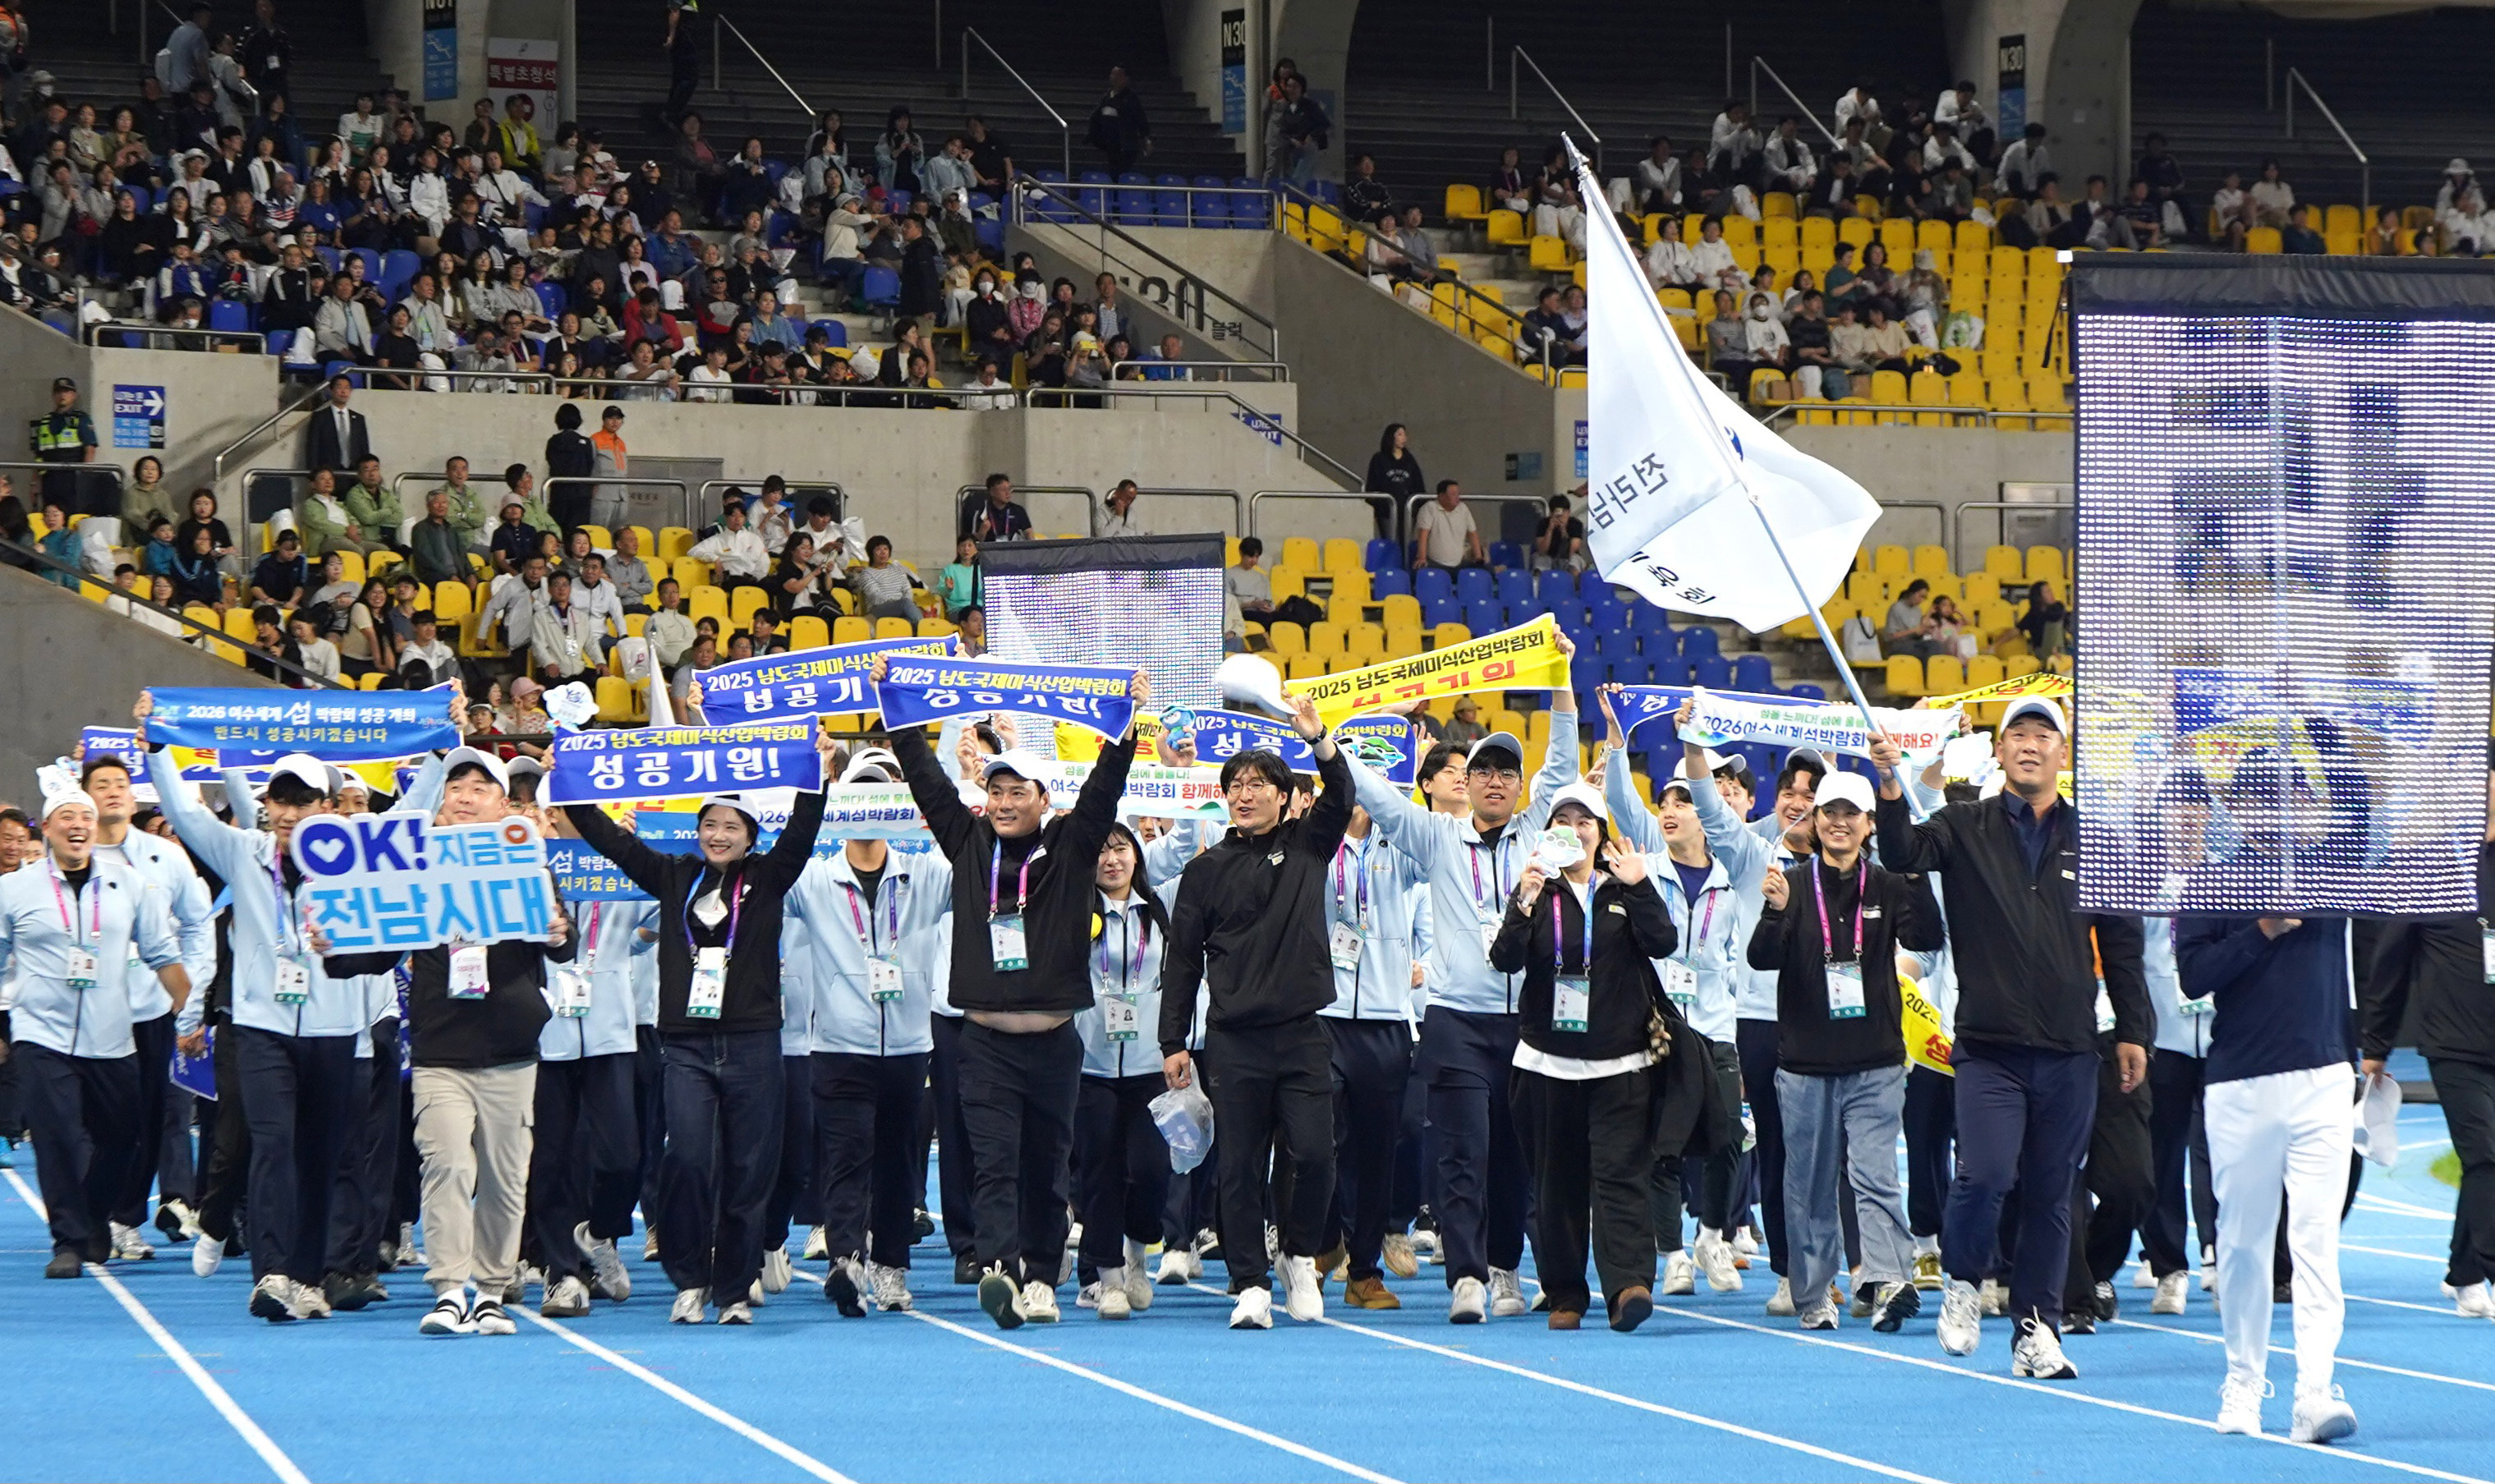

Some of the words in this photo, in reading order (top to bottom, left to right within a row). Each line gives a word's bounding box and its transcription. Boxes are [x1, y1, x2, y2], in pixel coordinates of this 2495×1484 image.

[113, 403, 143, 413] EXIT
[706, 671, 754, 692] 2025
[890, 667, 936, 684] 2025
[939, 669, 1127, 696] 남도국제미식산업박람회
[1307, 679, 1351, 701] 2025
[186, 705, 227, 719] 2026
[227, 705, 283, 723] 여수세계
[283, 700, 311, 726] 섬
[315, 707, 356, 724] 박람회
[358, 707, 387, 724] 성공
[388, 707, 416, 724] 개최
[88, 737, 130, 750] 2025
[214, 725, 260, 742] 반드시
[266, 726, 388, 743] 성공시키겠습니다
[559, 733, 607, 752] 2025
[610, 724, 808, 750] 남도국제미식산업박람회
[587, 747, 781, 790] 성공기원!
[299, 818, 429, 875] OK!
[432, 824, 535, 866] 지금은
[548, 851, 573, 874] 섬
